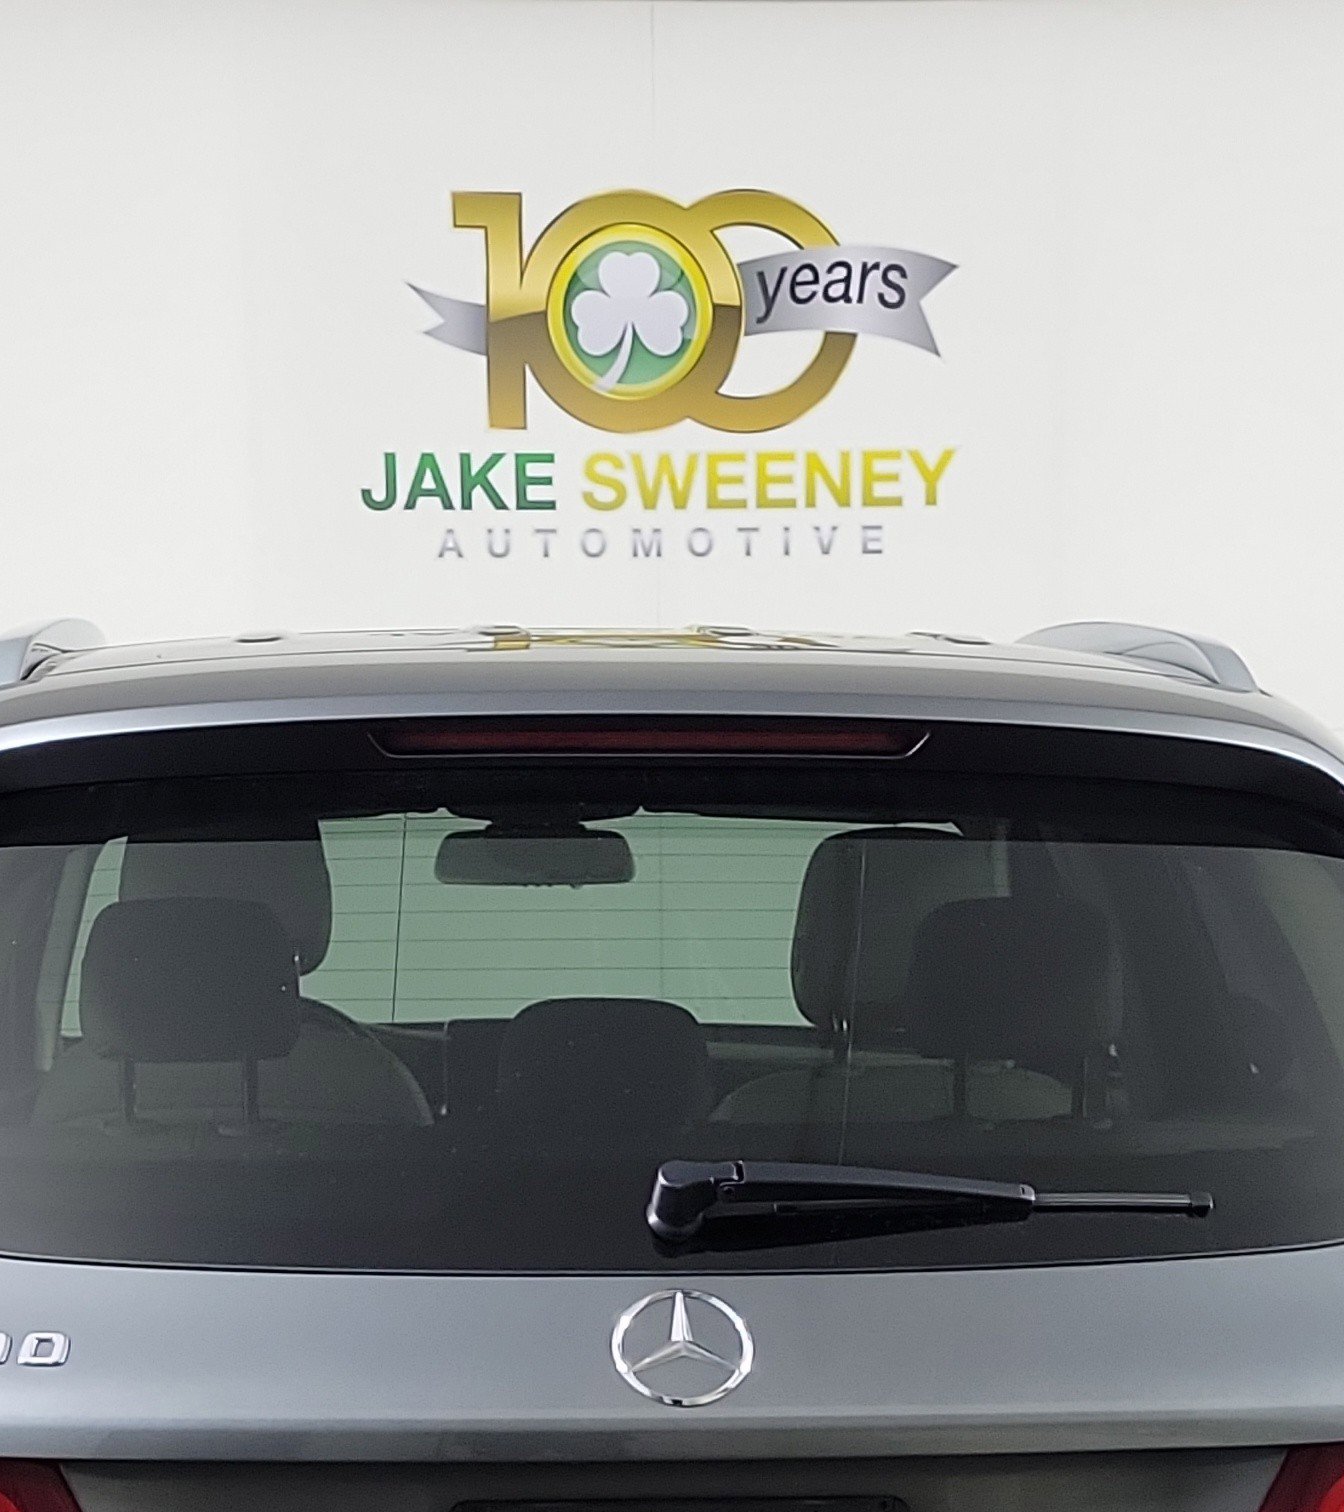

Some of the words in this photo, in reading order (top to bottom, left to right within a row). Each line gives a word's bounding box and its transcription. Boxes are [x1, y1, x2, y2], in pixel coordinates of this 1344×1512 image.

[756, 258, 909, 323] years
[360, 452, 557, 511] JAKE
[581, 448, 956, 510] SWEENEY
[437, 525, 885, 559] AUTOMOTIVE
